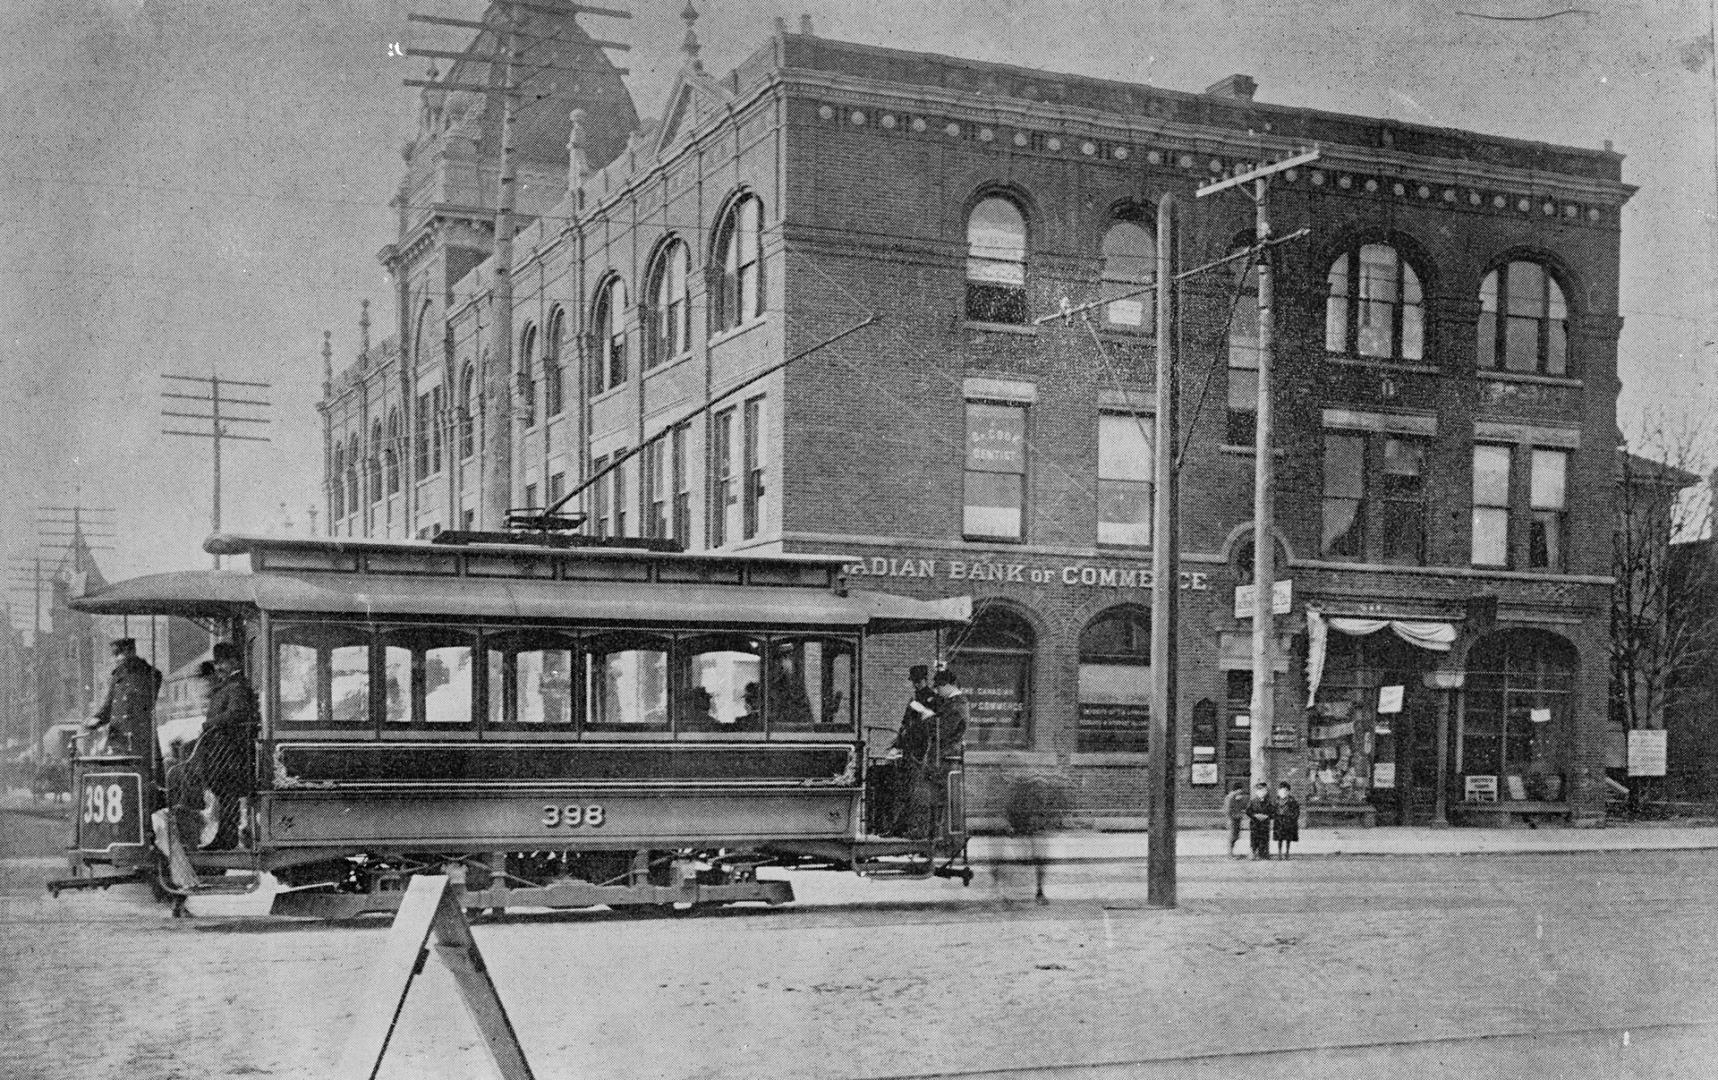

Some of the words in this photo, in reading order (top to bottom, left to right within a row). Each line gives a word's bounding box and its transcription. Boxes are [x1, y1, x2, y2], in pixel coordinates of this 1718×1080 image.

[852, 556, 935, 578] ADIAN
[949, 561, 1024, 582] BANK
[1061, 566, 1207, 590] COMMECE
[83, 784, 123, 824] 398
[541, 804, 604, 827] 398
